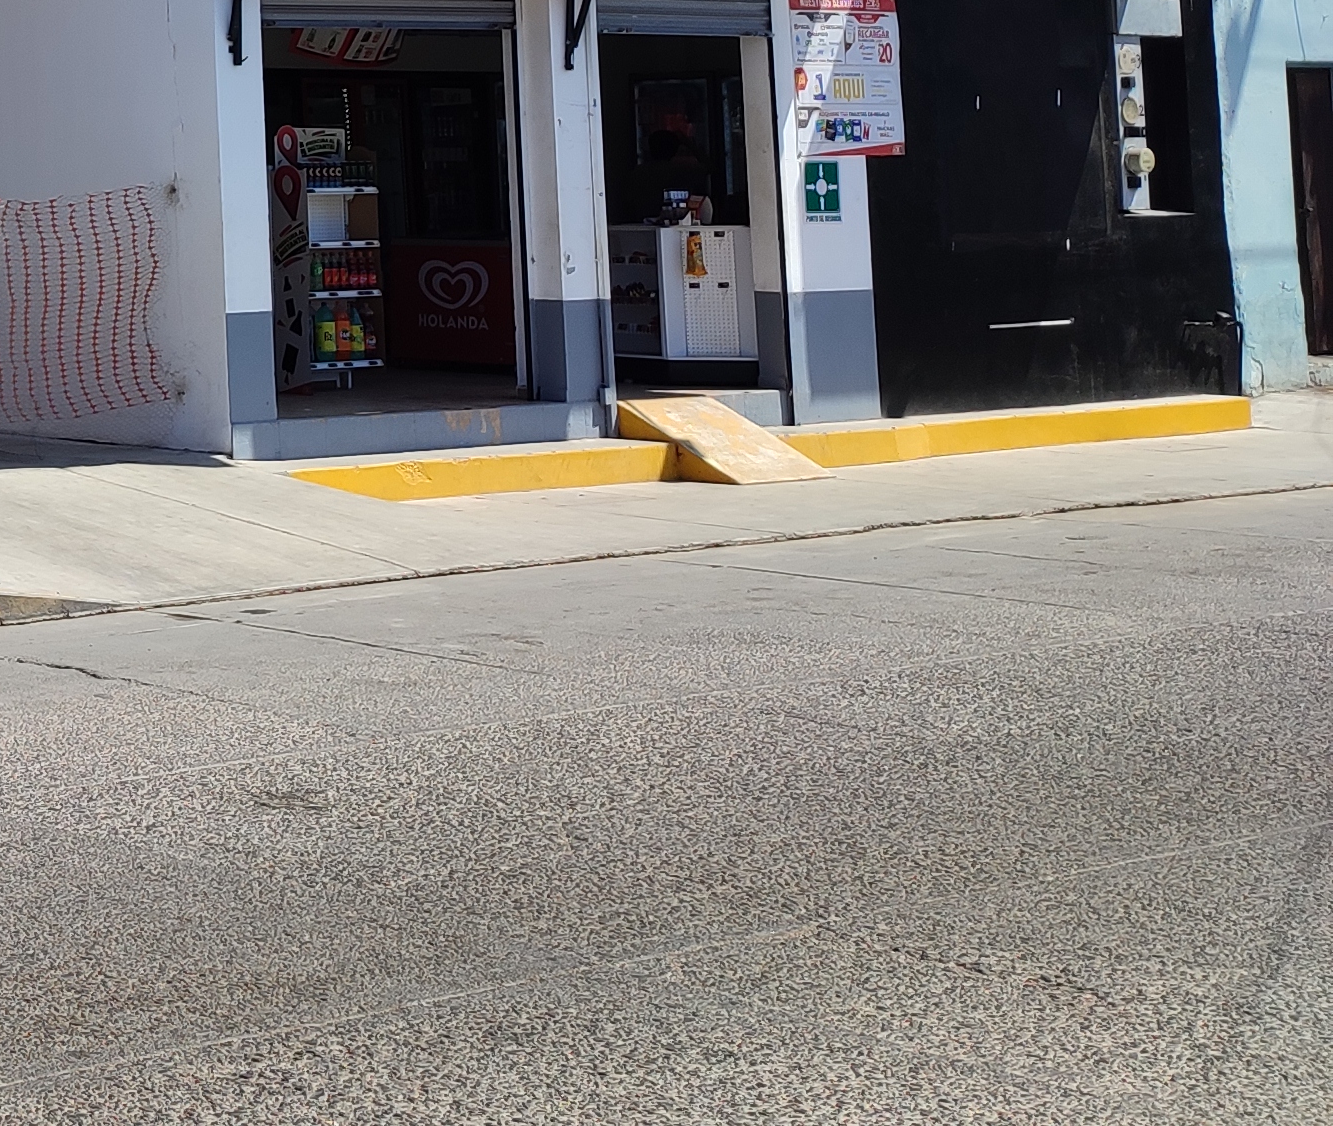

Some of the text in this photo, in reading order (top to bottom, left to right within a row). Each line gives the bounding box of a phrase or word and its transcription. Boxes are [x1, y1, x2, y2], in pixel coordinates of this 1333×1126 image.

[858, 29, 890, 39] RECARGAR
[1139, 105, 1144, 116] 2
[418, 313, 489, 330] HOLANDA
